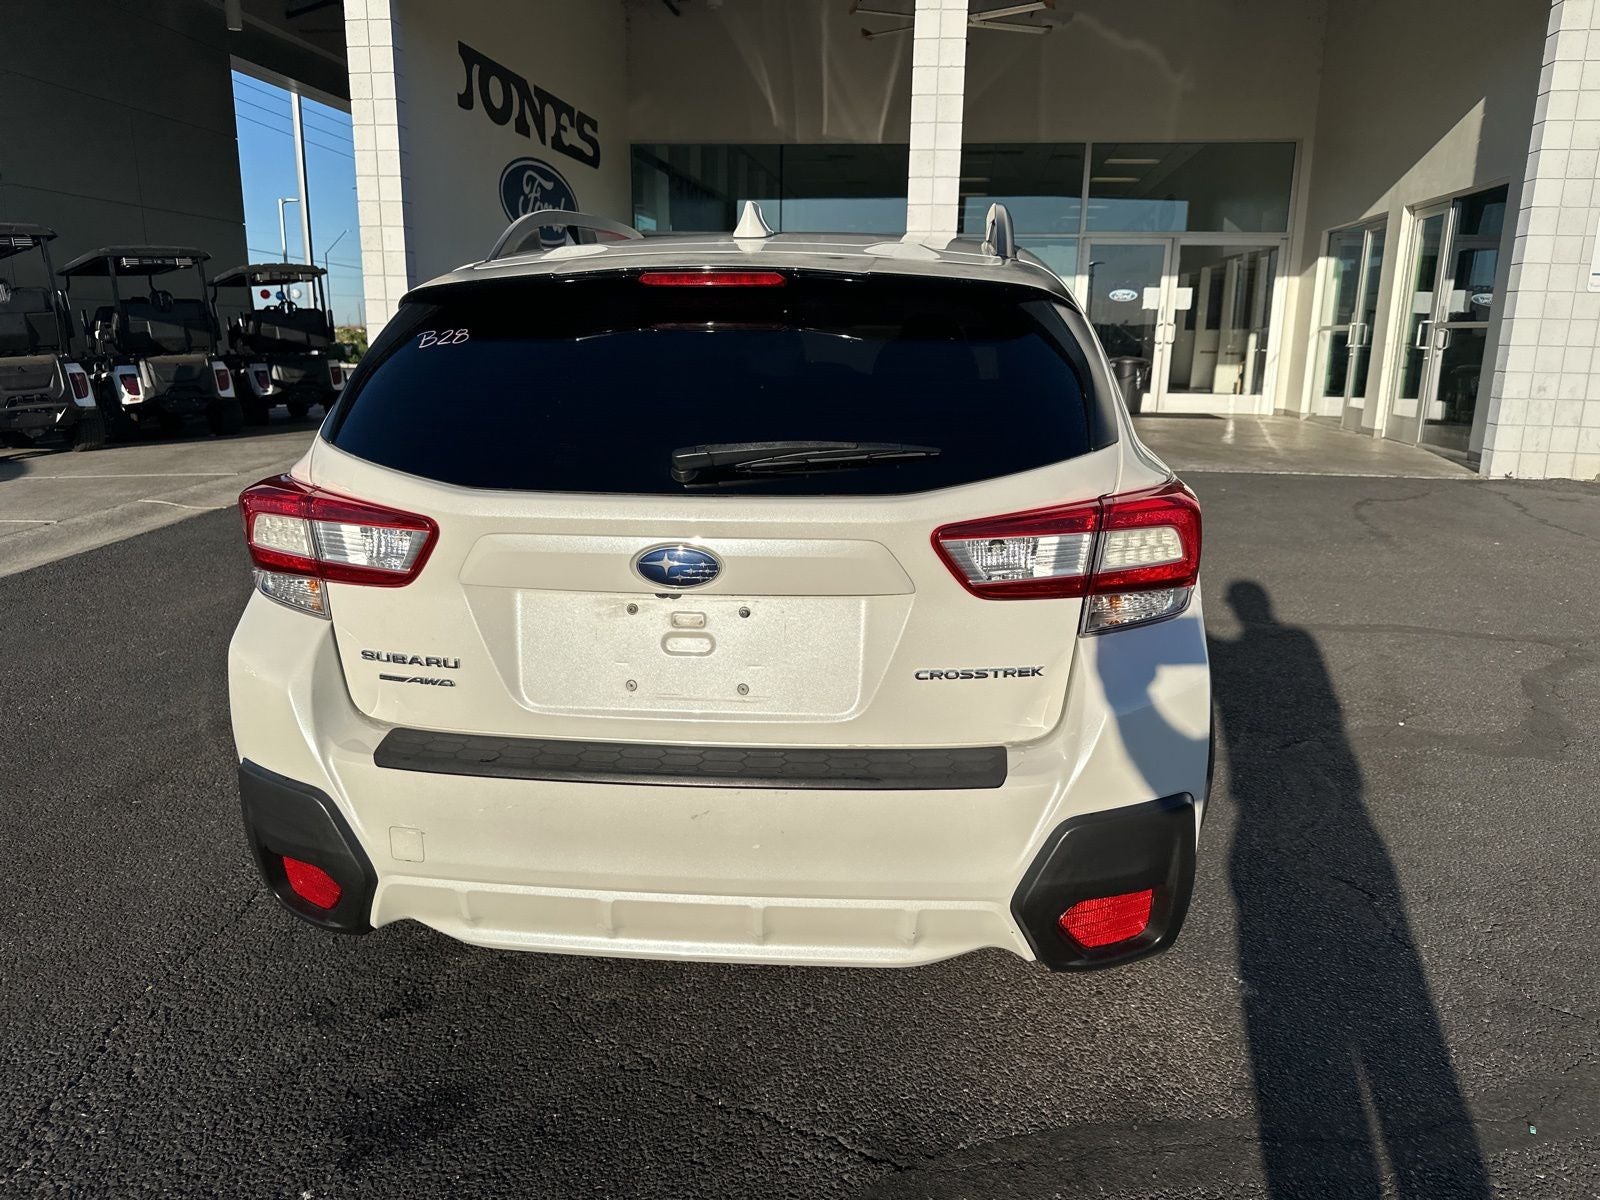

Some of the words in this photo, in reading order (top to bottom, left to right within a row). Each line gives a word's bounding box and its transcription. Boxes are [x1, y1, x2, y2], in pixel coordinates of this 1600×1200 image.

[457, 40, 600, 169] JONES
[417, 328, 469, 348] B28
[360, 649, 461, 669] SUBARU
[406, 676, 456, 688] AWD
[914, 665, 1045, 681] CROSSTREK
